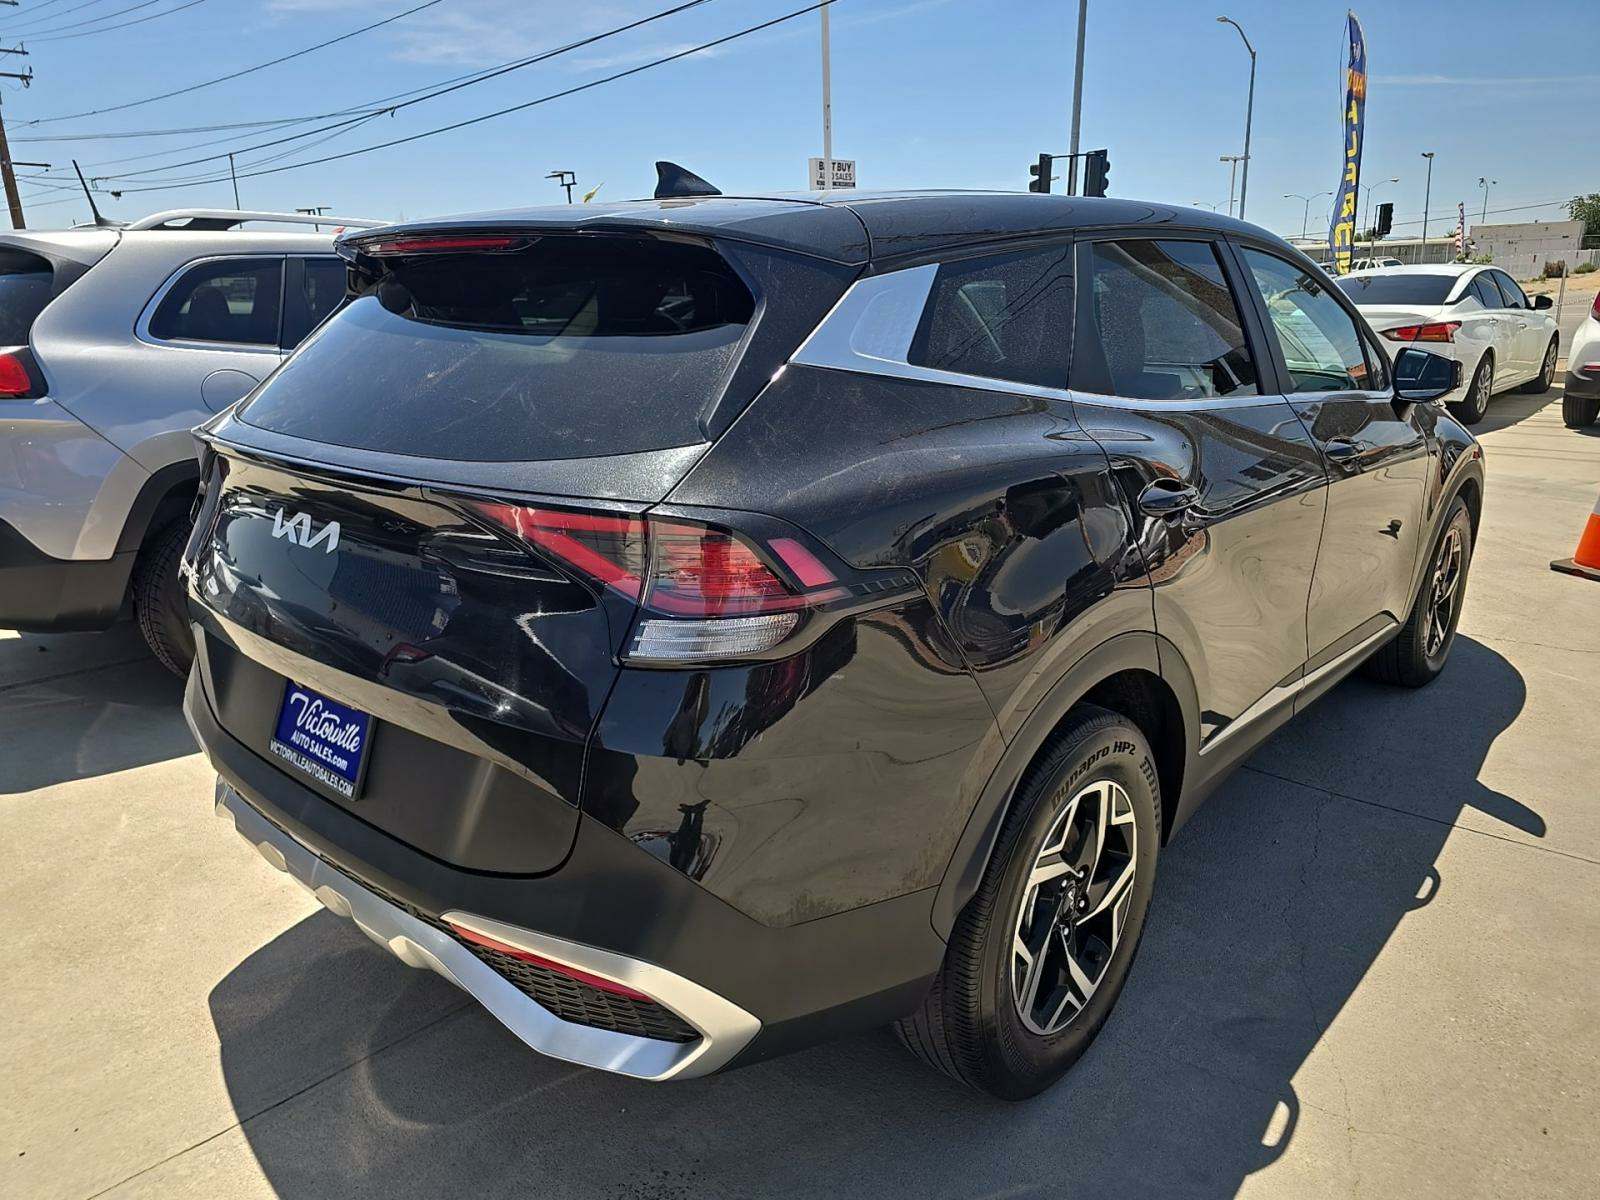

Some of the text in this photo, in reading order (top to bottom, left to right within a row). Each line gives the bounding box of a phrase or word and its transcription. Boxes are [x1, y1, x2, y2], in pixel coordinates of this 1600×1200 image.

[819, 161, 851, 172] BT BUY
[835, 172, 852, 180] SALES
[272, 507, 340, 554] KIA
[290, 692, 361, 752] Victorville
[290, 730, 310, 748] AUTO
[1112, 741, 1136, 755] HP2
